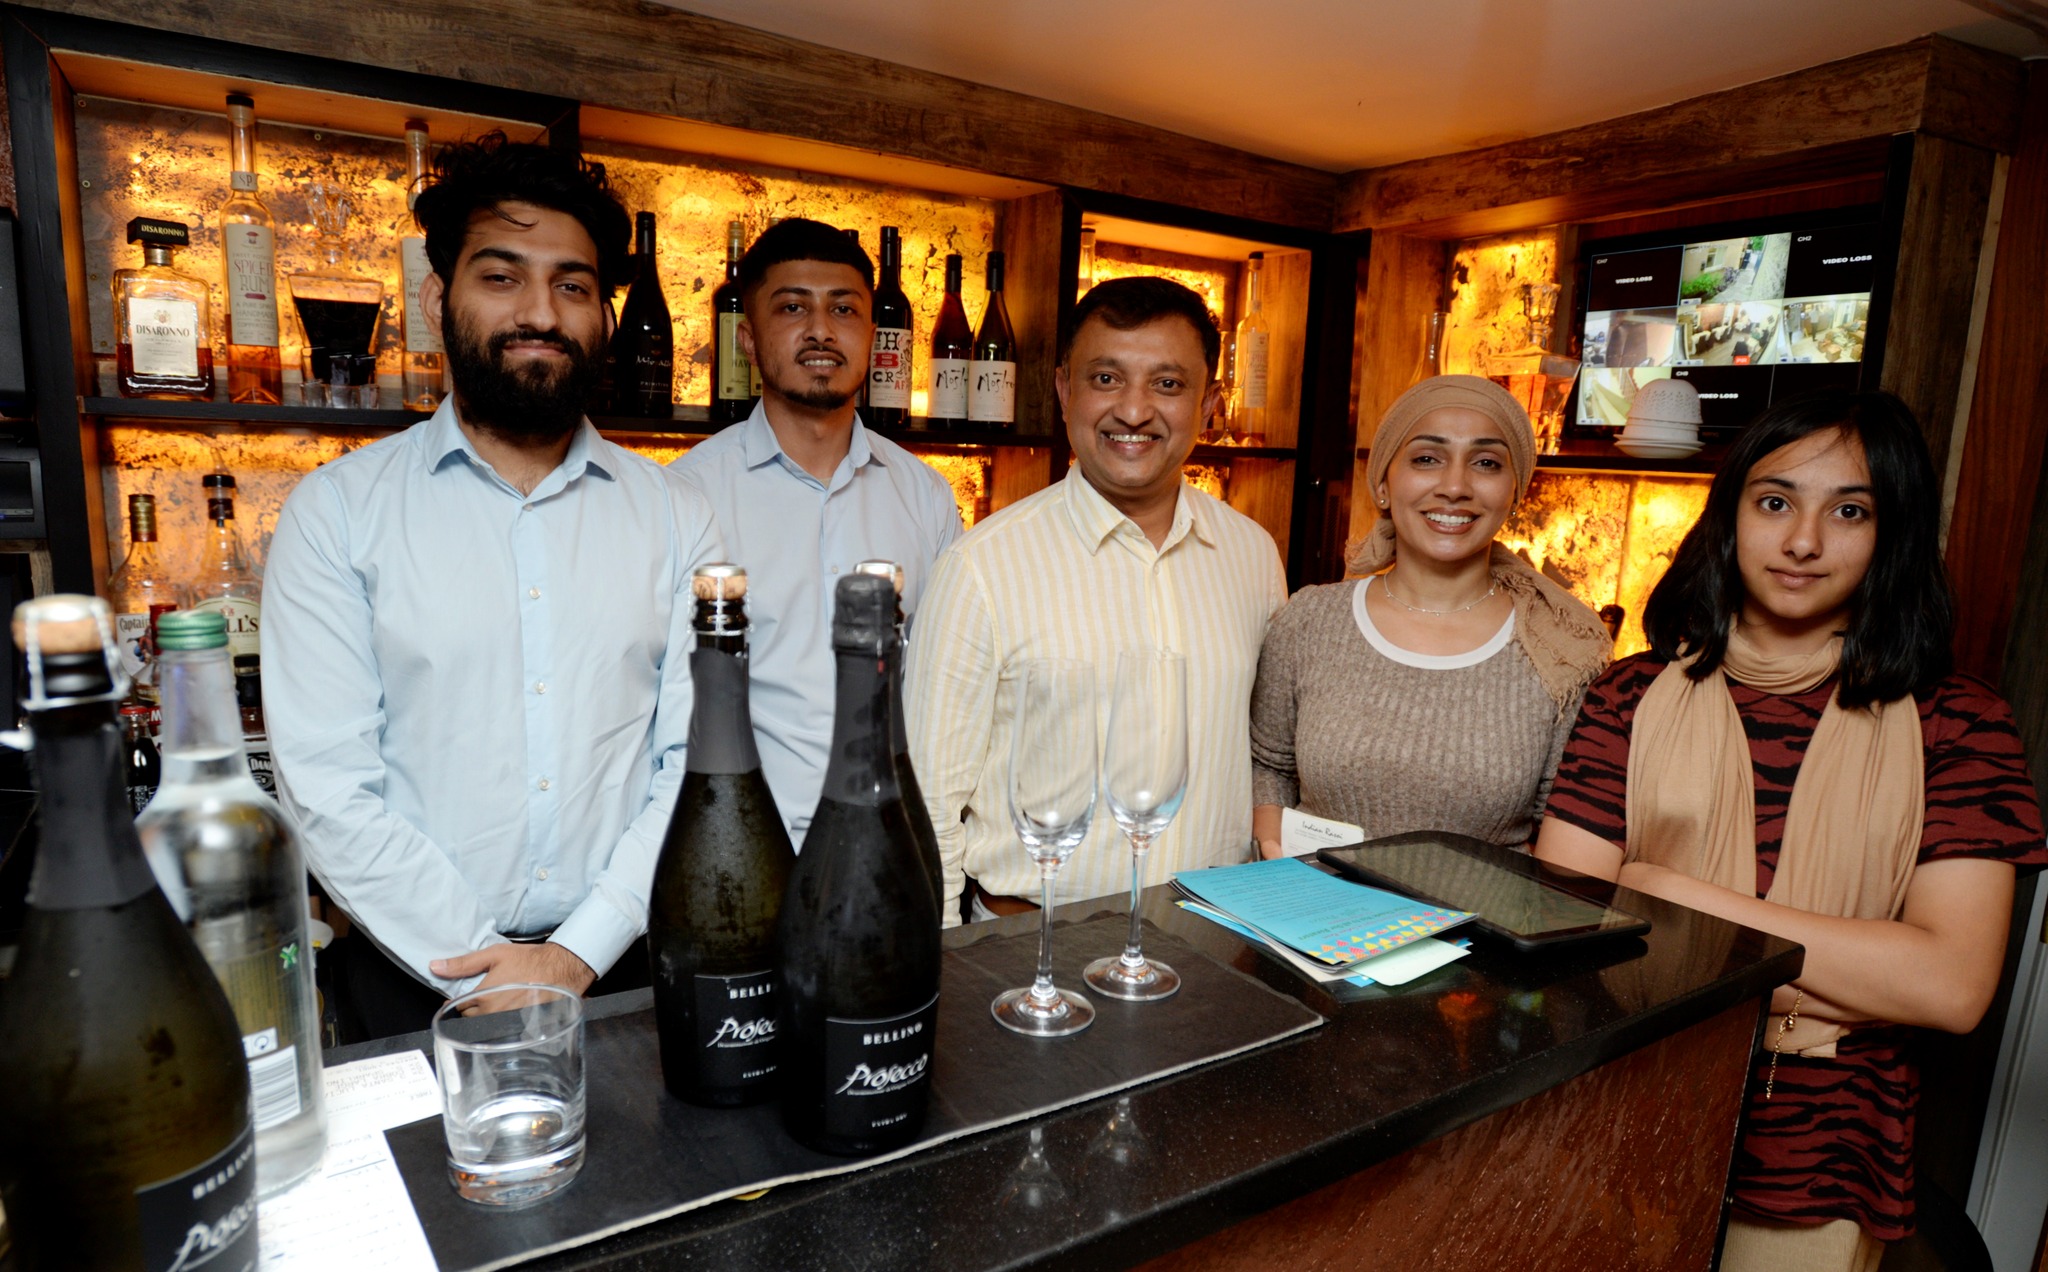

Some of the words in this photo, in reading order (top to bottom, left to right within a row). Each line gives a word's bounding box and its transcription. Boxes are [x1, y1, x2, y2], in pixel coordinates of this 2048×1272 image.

[141, 224, 185, 237] DISARONNO
[234, 260, 273, 276] SPICED
[1822, 257, 1848, 265] VIDEO
[239, 275, 271, 293] RUM
[1635, 275, 1653, 283] LOSS
[136, 324, 190, 338] DISARONNO
[1302, 821, 1324, 833] Indian
[863, 1021, 924, 1046] BELLINO
[835, 1053, 928, 1095] Prosecco
